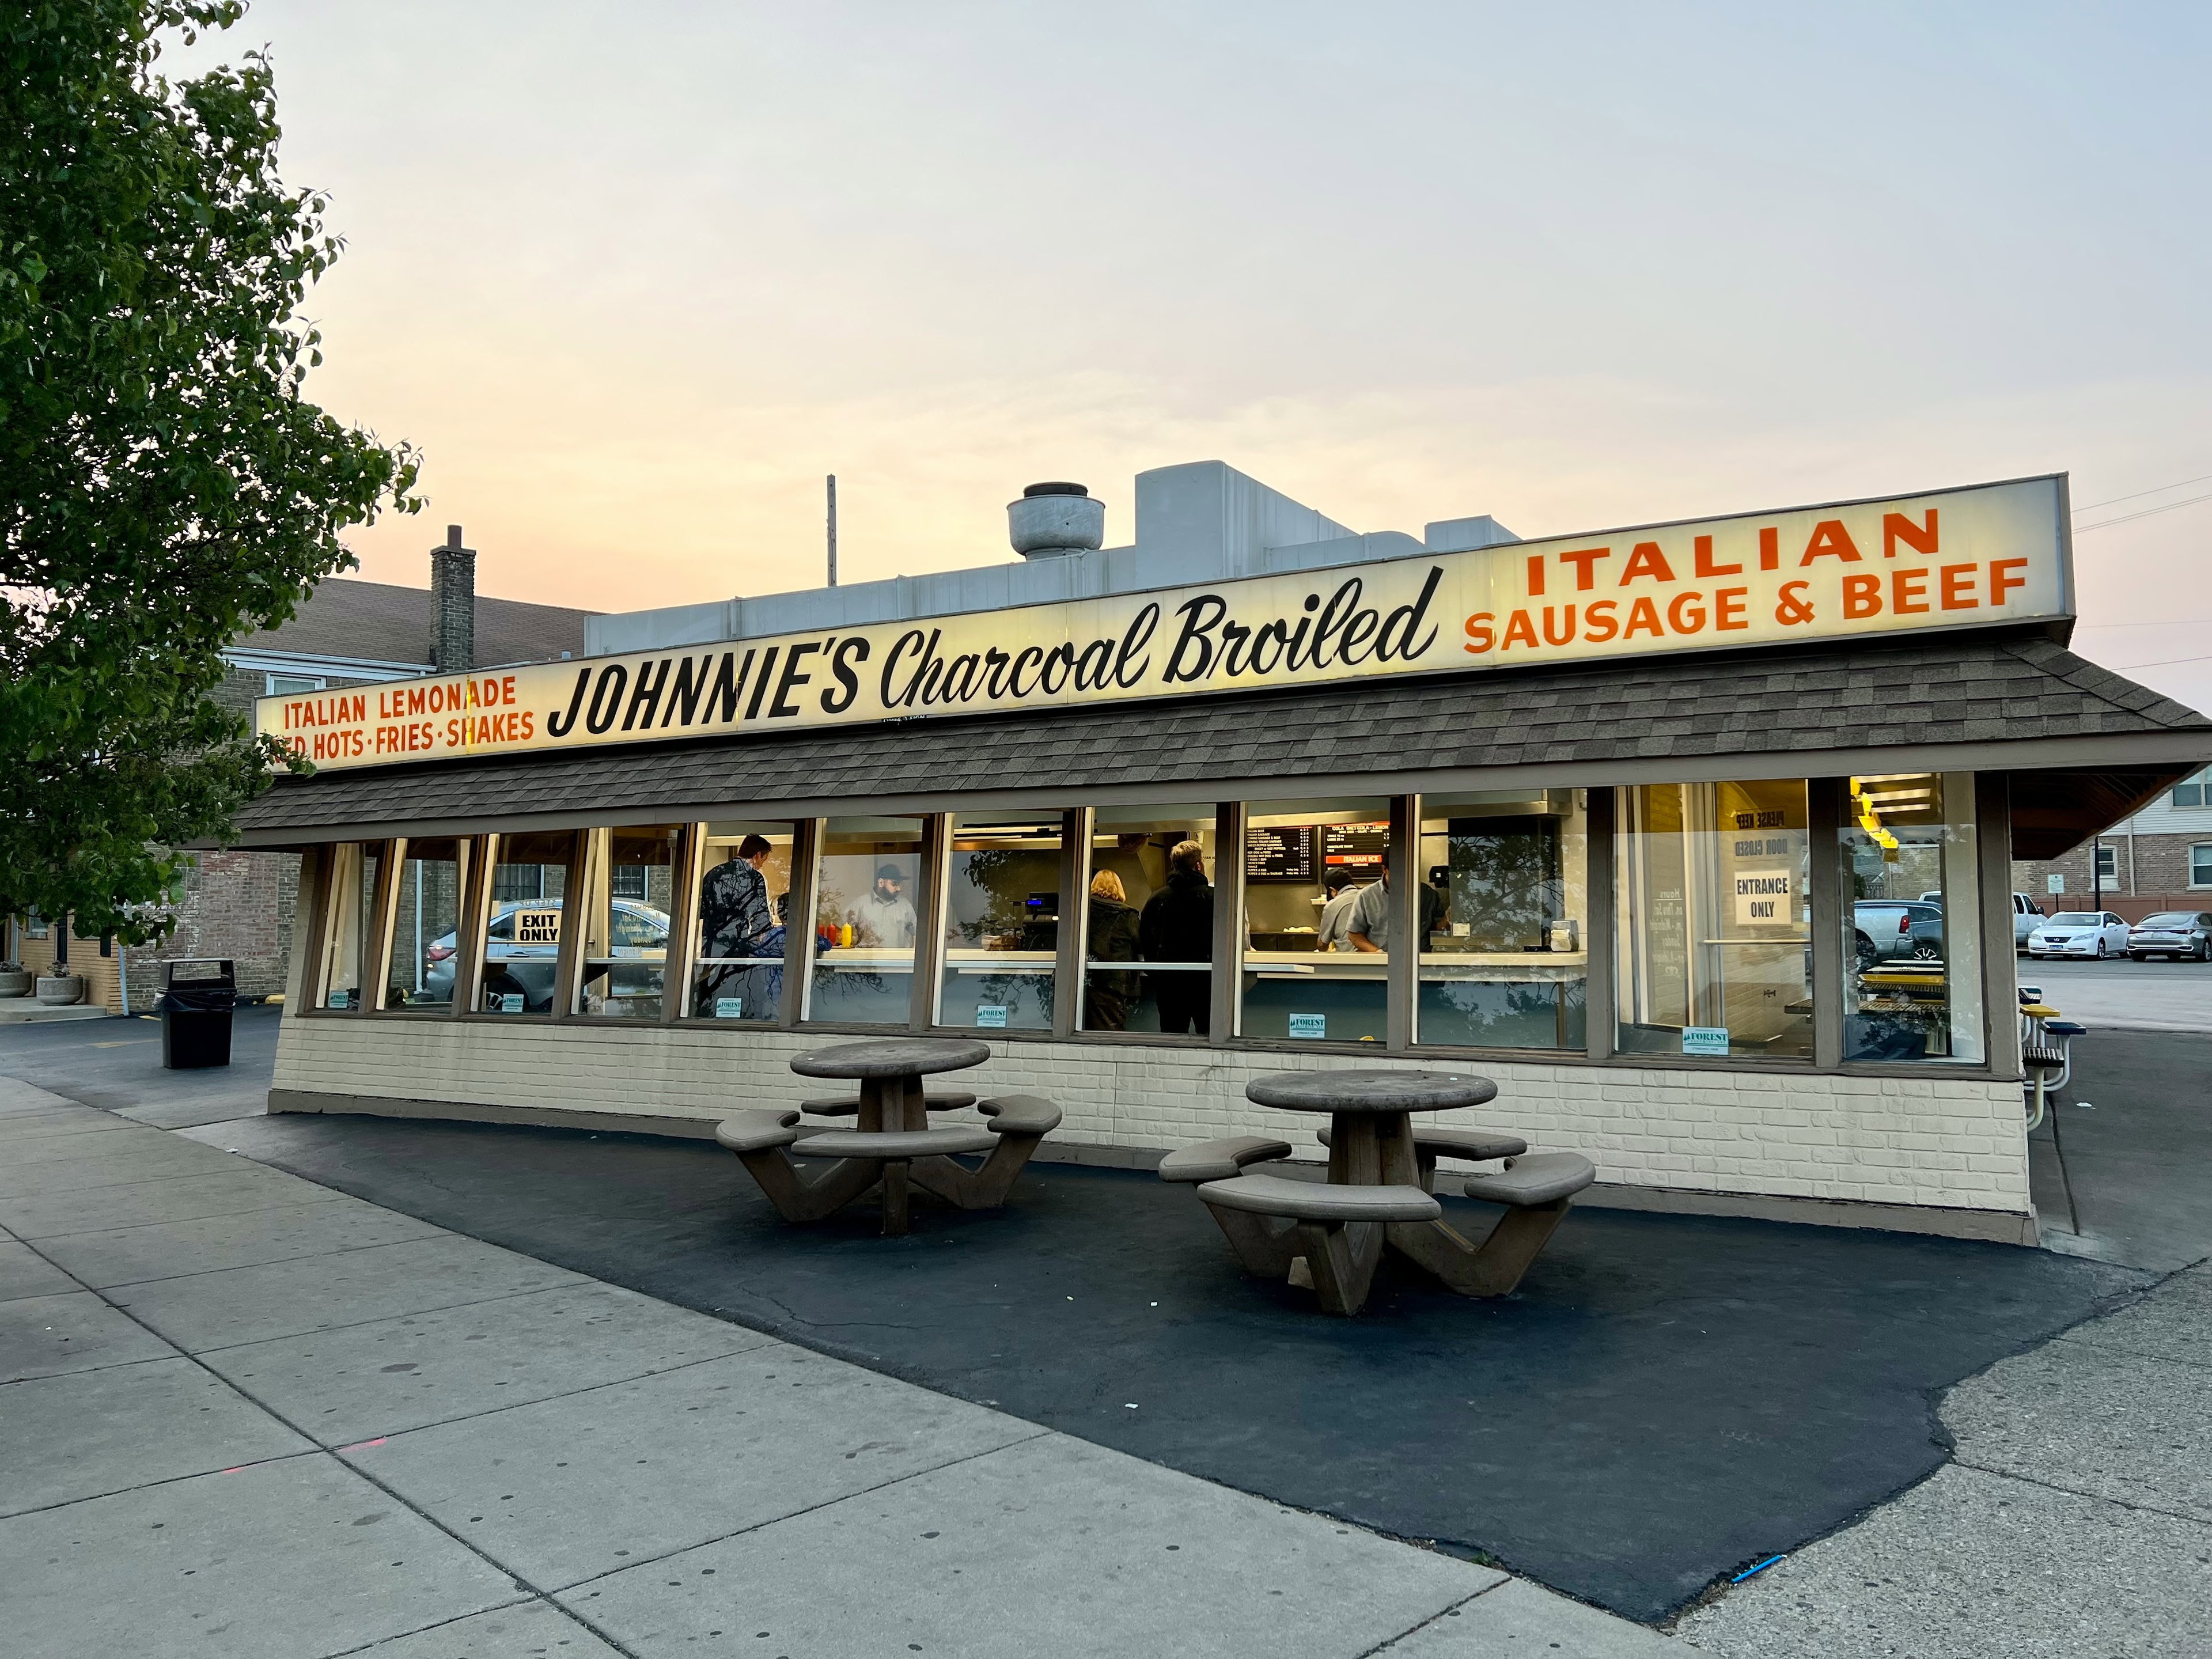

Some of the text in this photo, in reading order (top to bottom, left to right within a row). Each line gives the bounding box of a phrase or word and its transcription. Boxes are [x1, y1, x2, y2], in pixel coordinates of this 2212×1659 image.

[1527, 508, 1939, 596] ITALIAN
[1464, 557, 2028, 654] SAUSAGE & BEEF
[547, 565, 1444, 737] JOHNNIE'S Charcoal Broiled
[285, 676, 516, 729] ITALIAN LEMONADE
[314, 729, 363, 760] HOTS
[376, 722, 433, 754] FRIES
[446, 711, 534, 747] SHAKES
[1737, 877, 1788, 895] ENTRANCE
[522, 914, 556, 927] EXIT
[1751, 901, 1775, 918] ONLY
[520, 929, 559, 941] ONLY
[1691, 1032, 1728, 1041] FOREST
